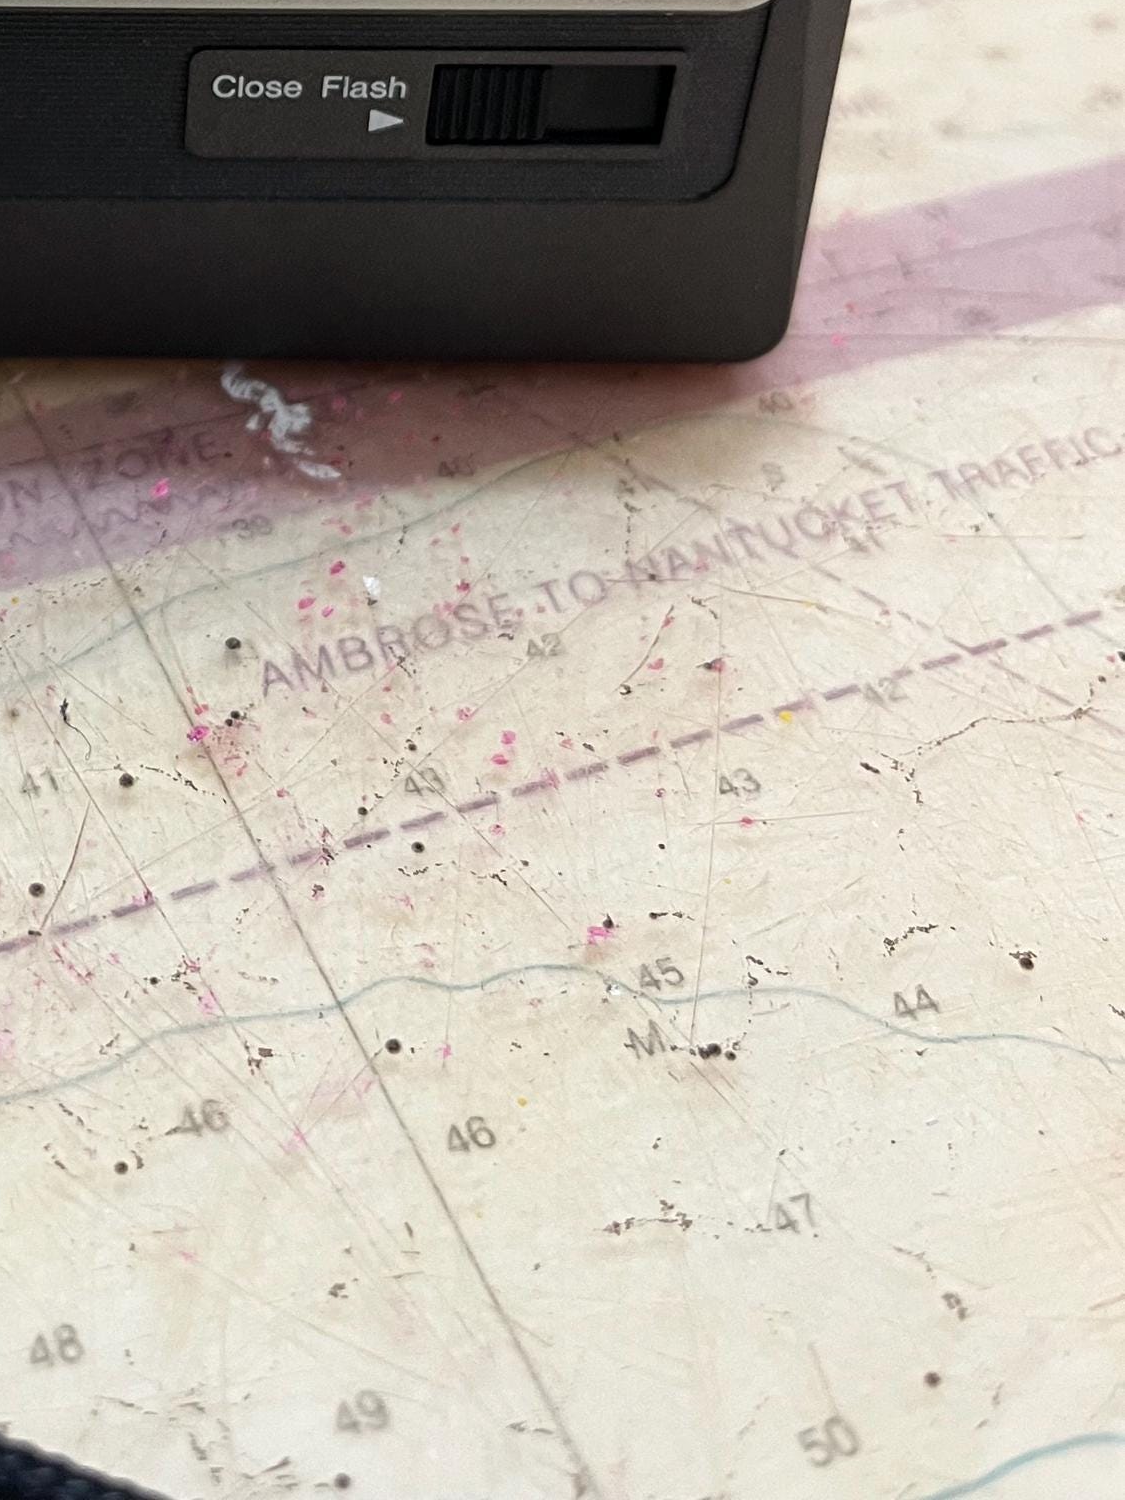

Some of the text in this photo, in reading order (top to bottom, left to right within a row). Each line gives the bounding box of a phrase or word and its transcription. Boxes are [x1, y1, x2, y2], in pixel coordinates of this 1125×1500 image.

[212, 75, 407, 100] Close Flash
[262, 592, 514, 697] AMBROSE
[533, 569, 608, 614] TO
[623, 479, 917, 592] NANTUCKET
[718, 767, 762, 799] 43
[639, 956, 685, 994] 45
[892, 985, 941, 1022] 44
[176, 1097, 230, 1137] 46
[446, 1115, 497, 1156] 46
[774, 1193, 818, 1235] 47
[28, 1323, 85, 1368] 48
[334, 1390, 391, 1436] 49
[797, 1415, 860, 1469] 50
